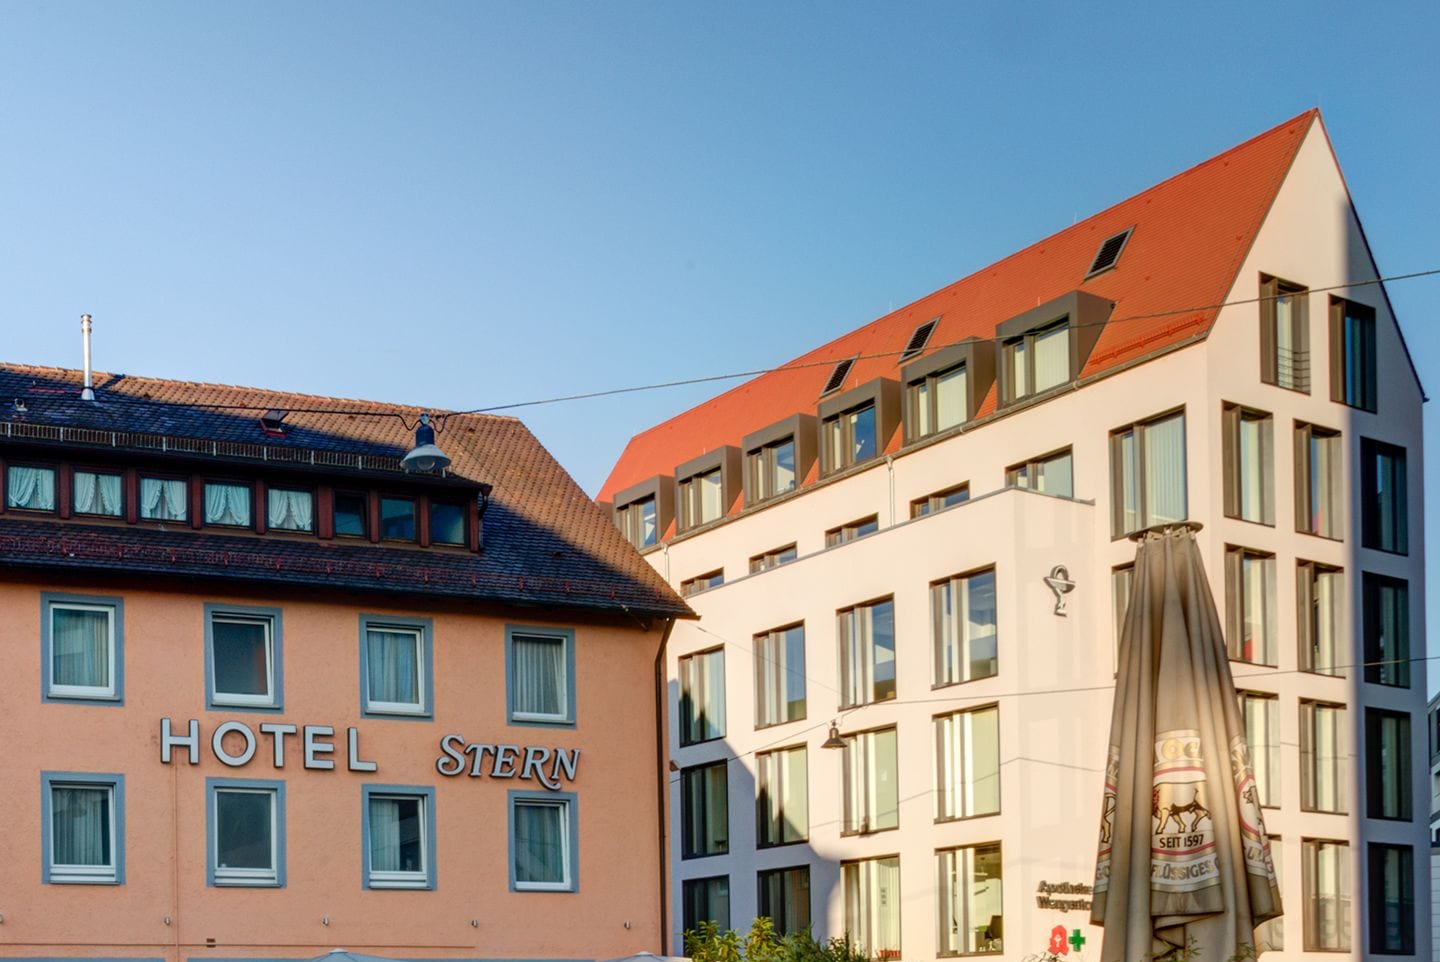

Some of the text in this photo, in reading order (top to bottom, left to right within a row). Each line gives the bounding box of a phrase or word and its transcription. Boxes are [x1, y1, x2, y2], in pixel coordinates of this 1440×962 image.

[160, 718, 582, 790] HOTEL STERN
[1159, 833, 1205, 849] SEIT 1597
[1151, 858, 1215, 882] FLÜSSIGES
